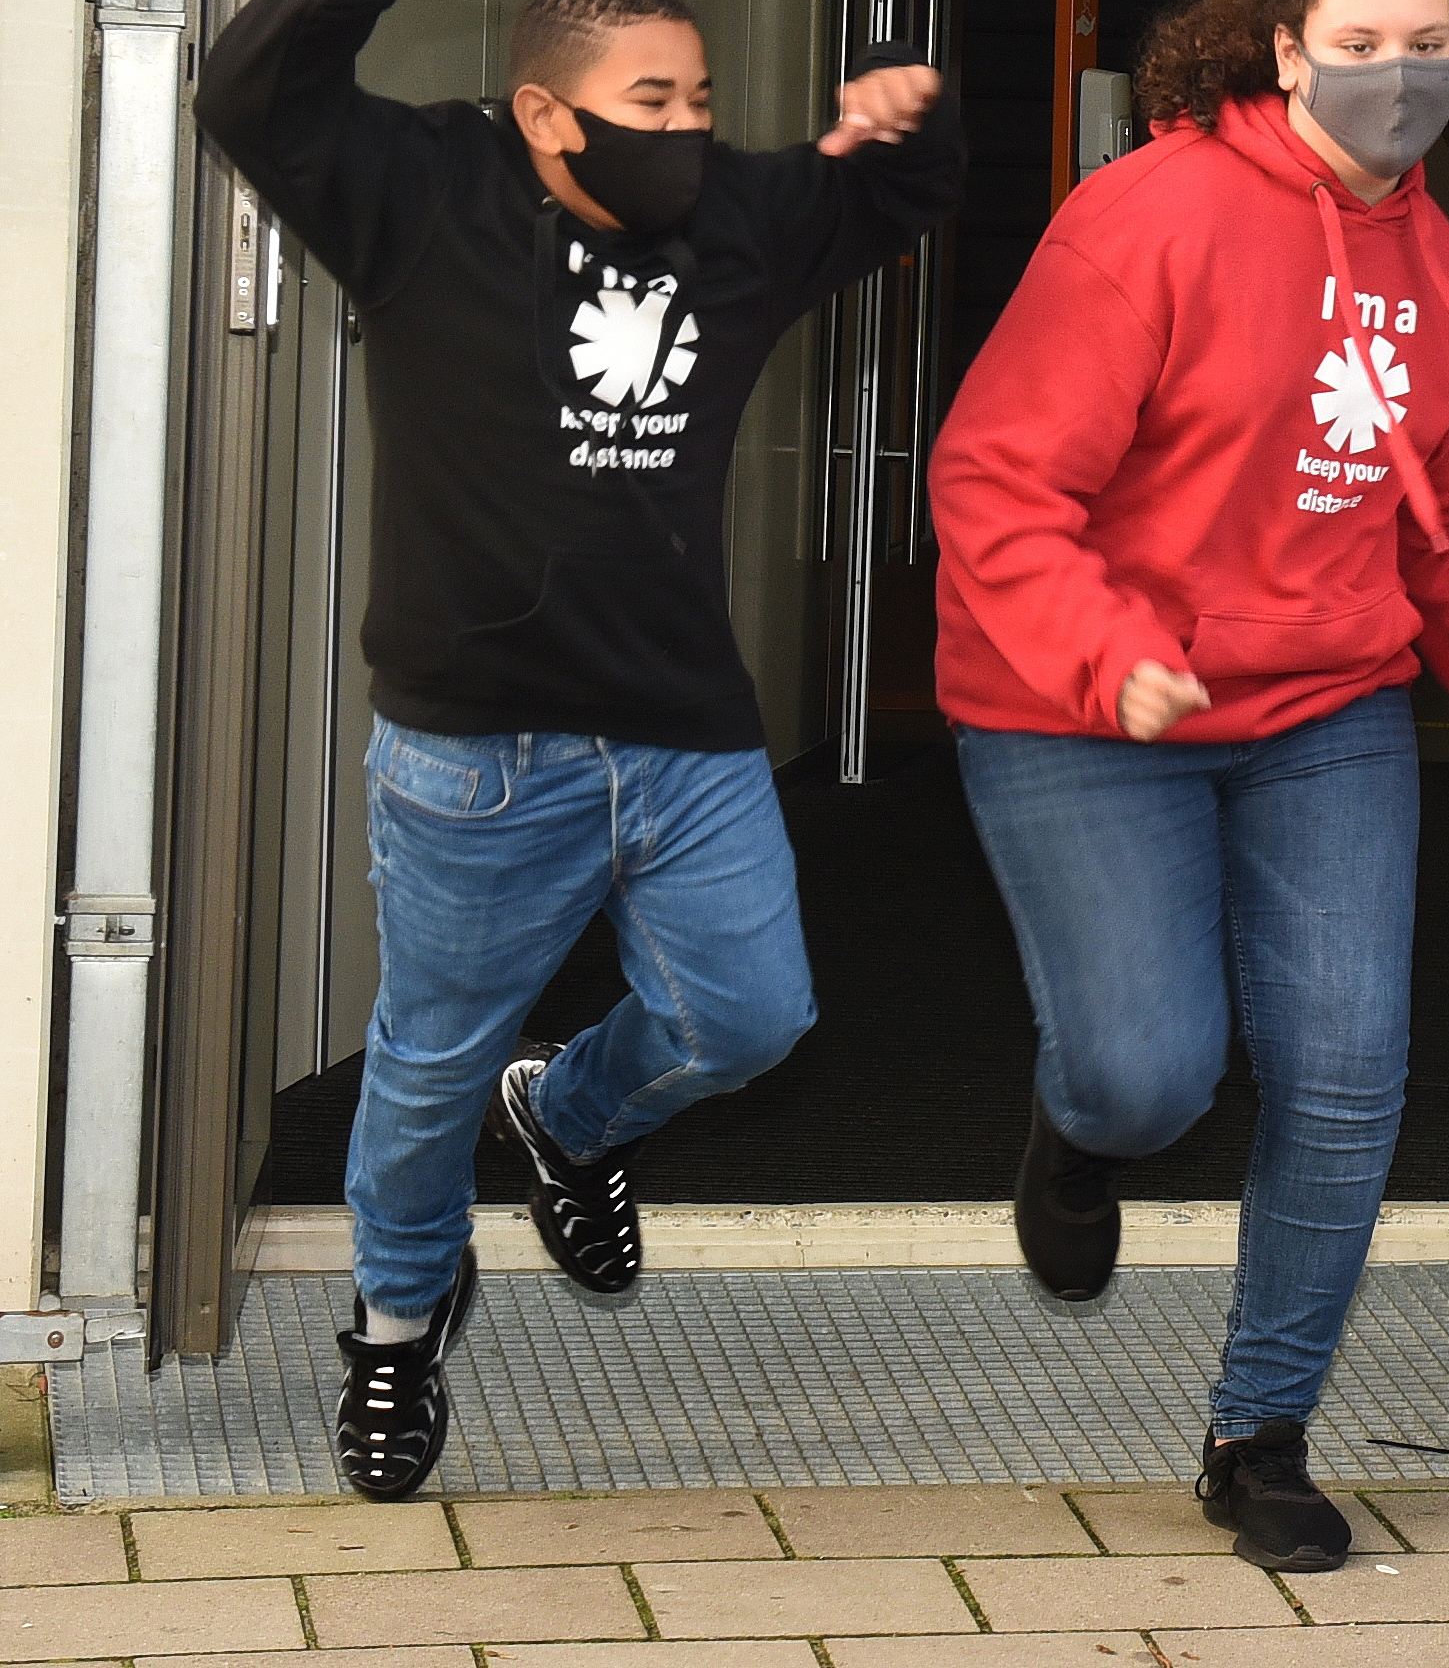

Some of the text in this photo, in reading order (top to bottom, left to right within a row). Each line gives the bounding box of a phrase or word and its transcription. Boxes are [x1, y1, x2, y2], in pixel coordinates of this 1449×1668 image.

[1394, 299, 1417, 334] a
[631, 413, 690, 439] your
[1296, 448, 1341, 483] keep
